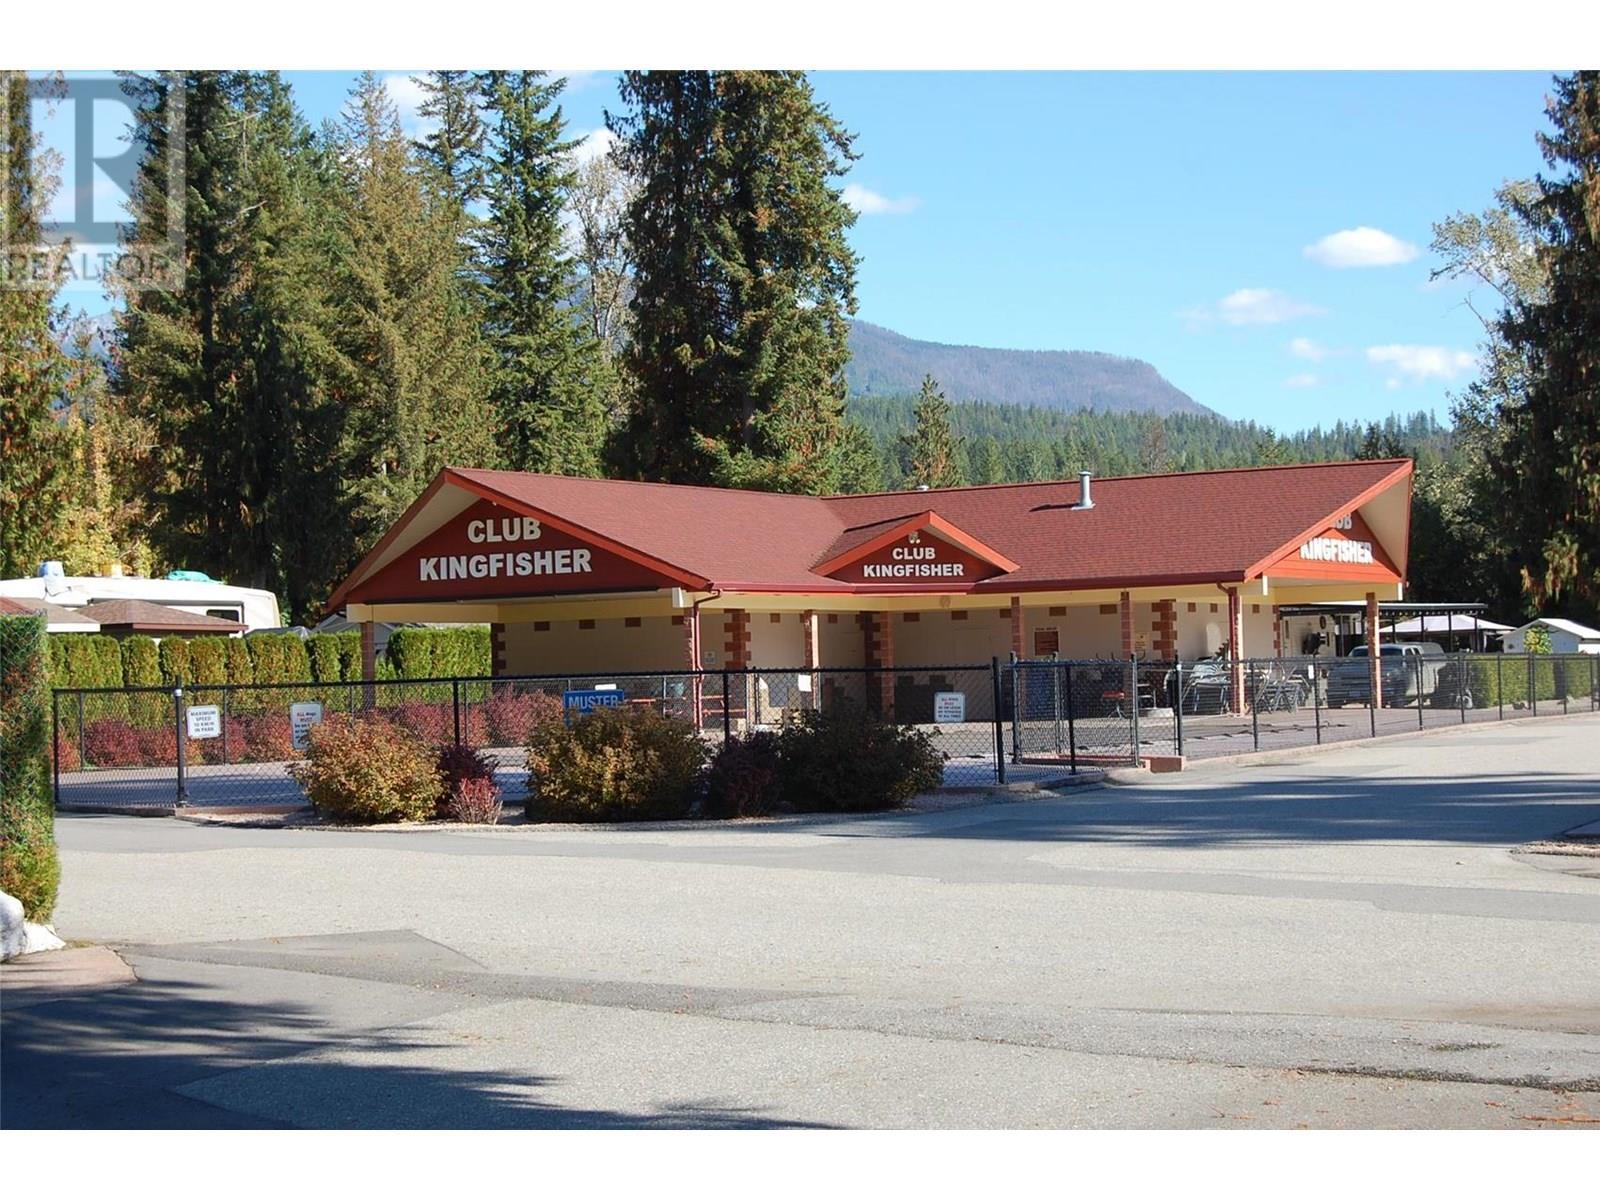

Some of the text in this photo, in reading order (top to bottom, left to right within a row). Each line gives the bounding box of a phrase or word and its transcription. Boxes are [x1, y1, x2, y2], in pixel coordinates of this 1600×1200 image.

[467, 517, 542, 543] CLUB
[892, 547, 936, 560] CLUB
[419, 548, 592, 582] KINGFISHER
[863, 563, 965, 578] KINGFISHER
[568, 693, 619, 710] MUSTER
